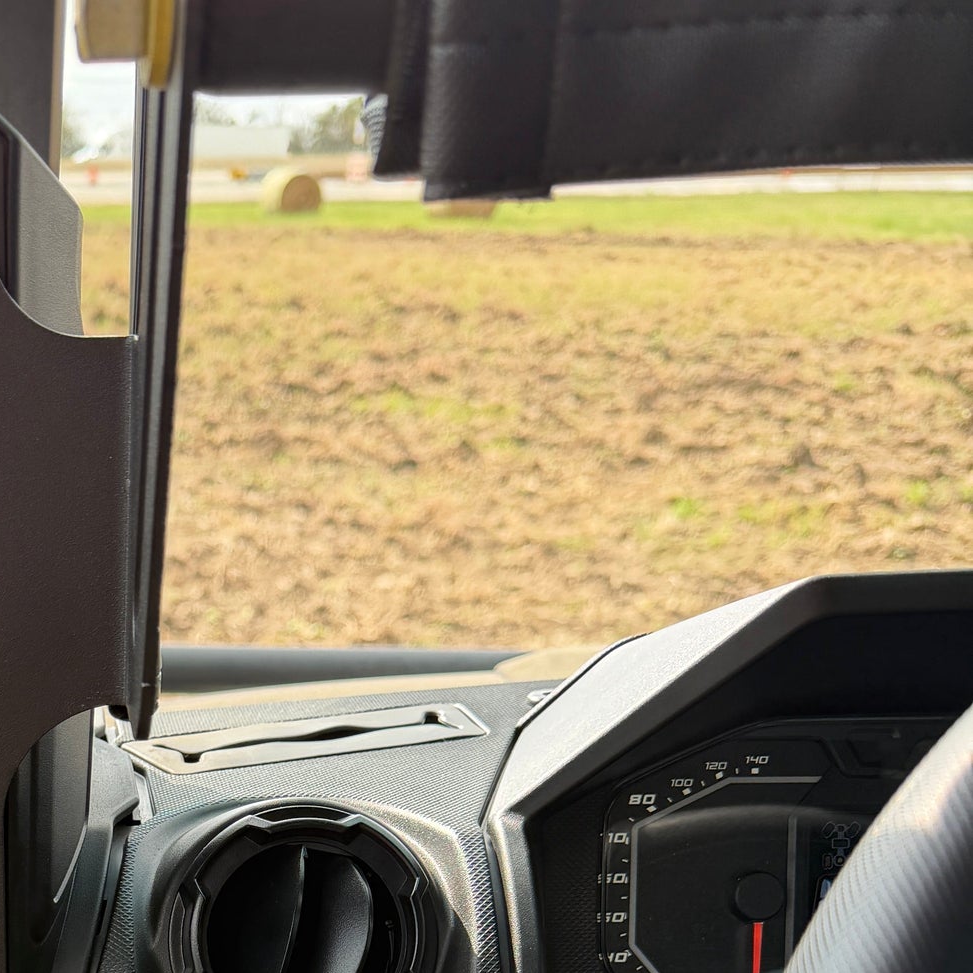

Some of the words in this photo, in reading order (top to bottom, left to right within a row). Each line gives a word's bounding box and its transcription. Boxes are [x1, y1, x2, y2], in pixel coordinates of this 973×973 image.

[745, 755, 769, 764] 140
[705, 761, 728, 770] 120
[670, 778, 694, 787] 100
[628, 794, 656, 805] 80
